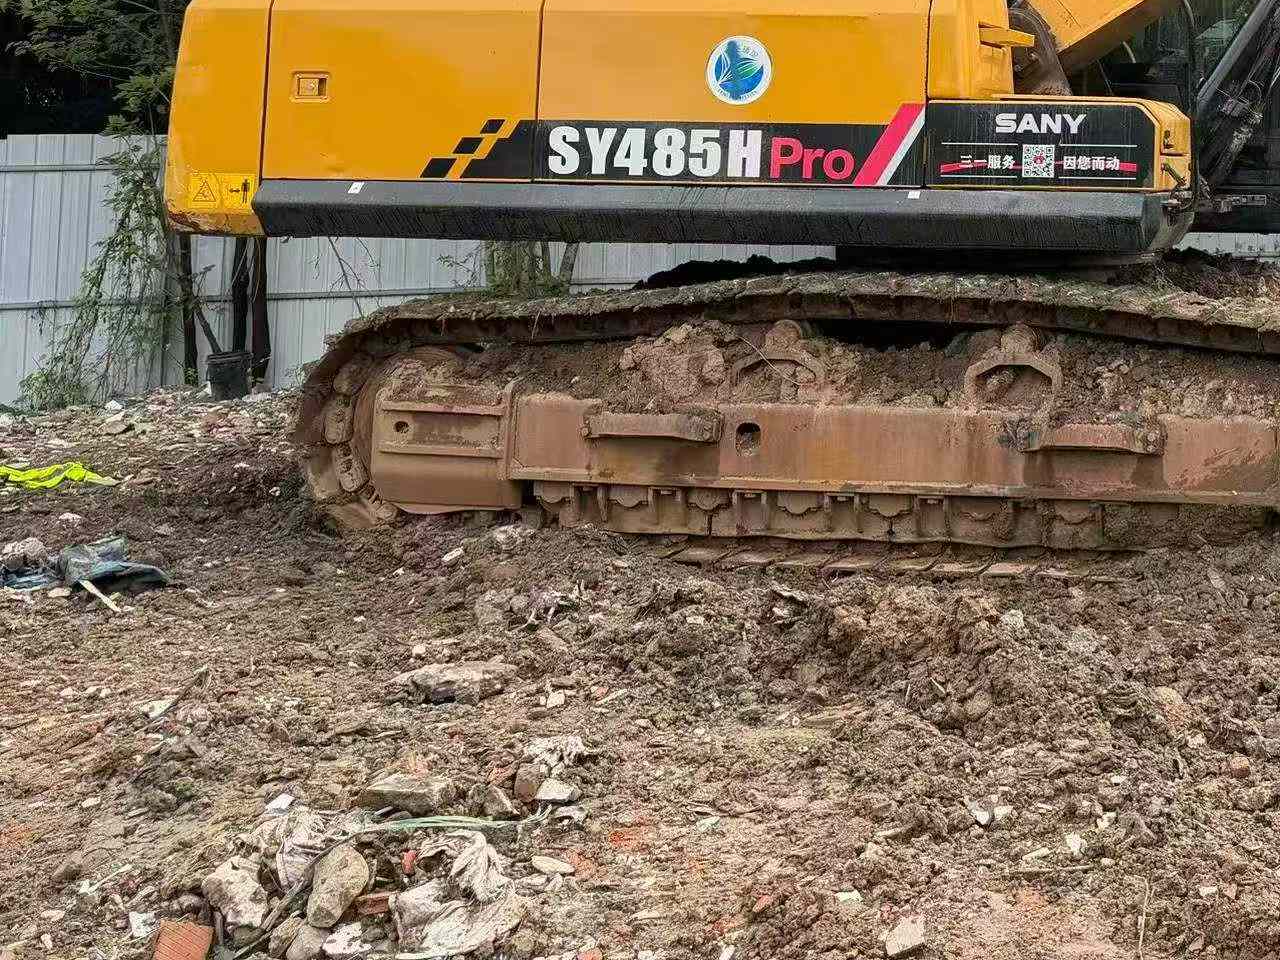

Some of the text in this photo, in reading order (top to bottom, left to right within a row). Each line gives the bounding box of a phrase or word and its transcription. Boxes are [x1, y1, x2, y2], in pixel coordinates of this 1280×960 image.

[995, 113, 1087, 134] SANY
[547, 126, 857, 179] SY485H Pro
[959, 154, 1120, 171] 三一服务 因您而动
